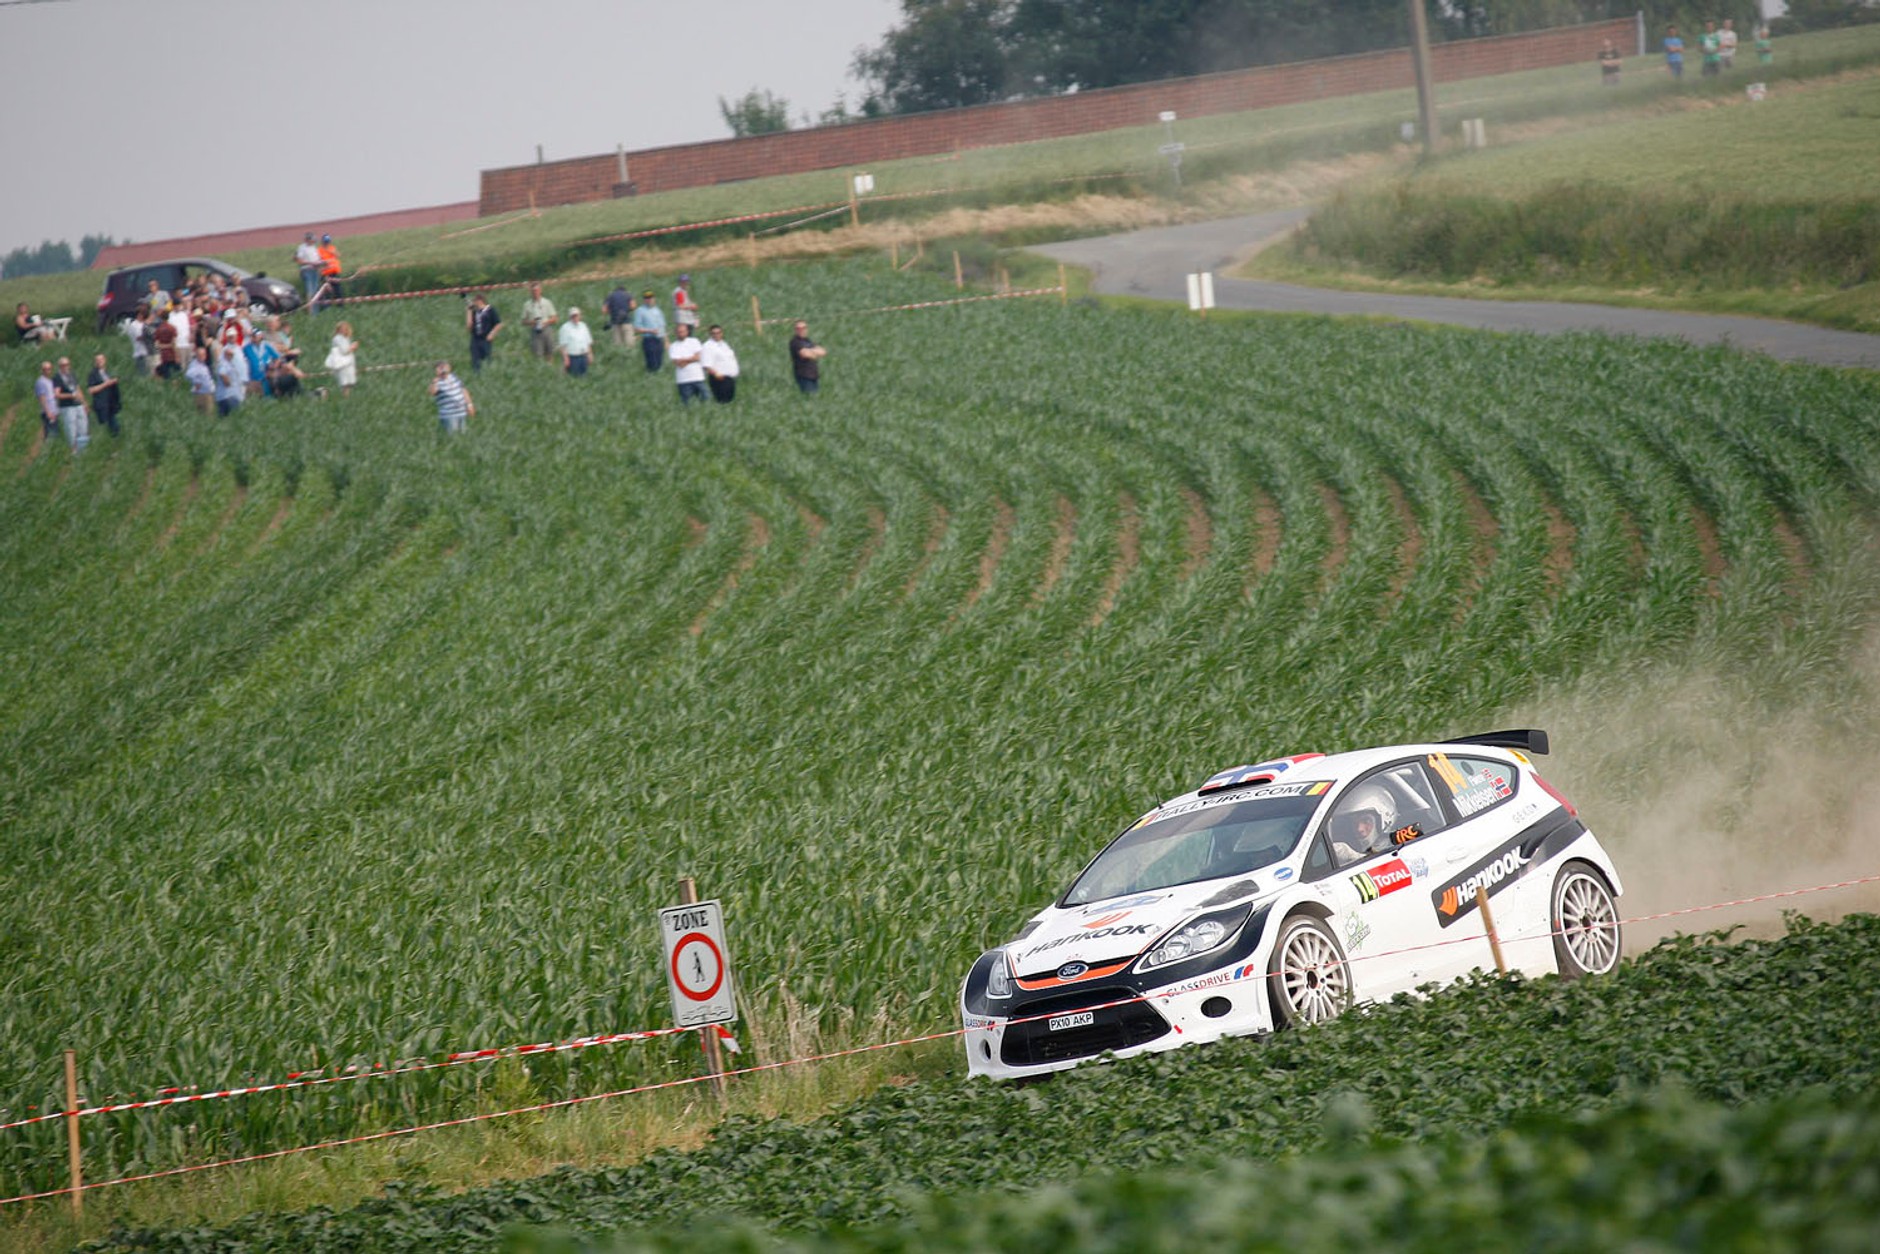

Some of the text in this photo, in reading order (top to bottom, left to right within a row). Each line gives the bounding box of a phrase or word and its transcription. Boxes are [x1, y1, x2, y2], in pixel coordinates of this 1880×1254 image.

[1352, 872, 1378, 902] 14
[673, 910, 709, 931] ZONE
[1051, 1014, 1092, 1029] PX10 AKP
